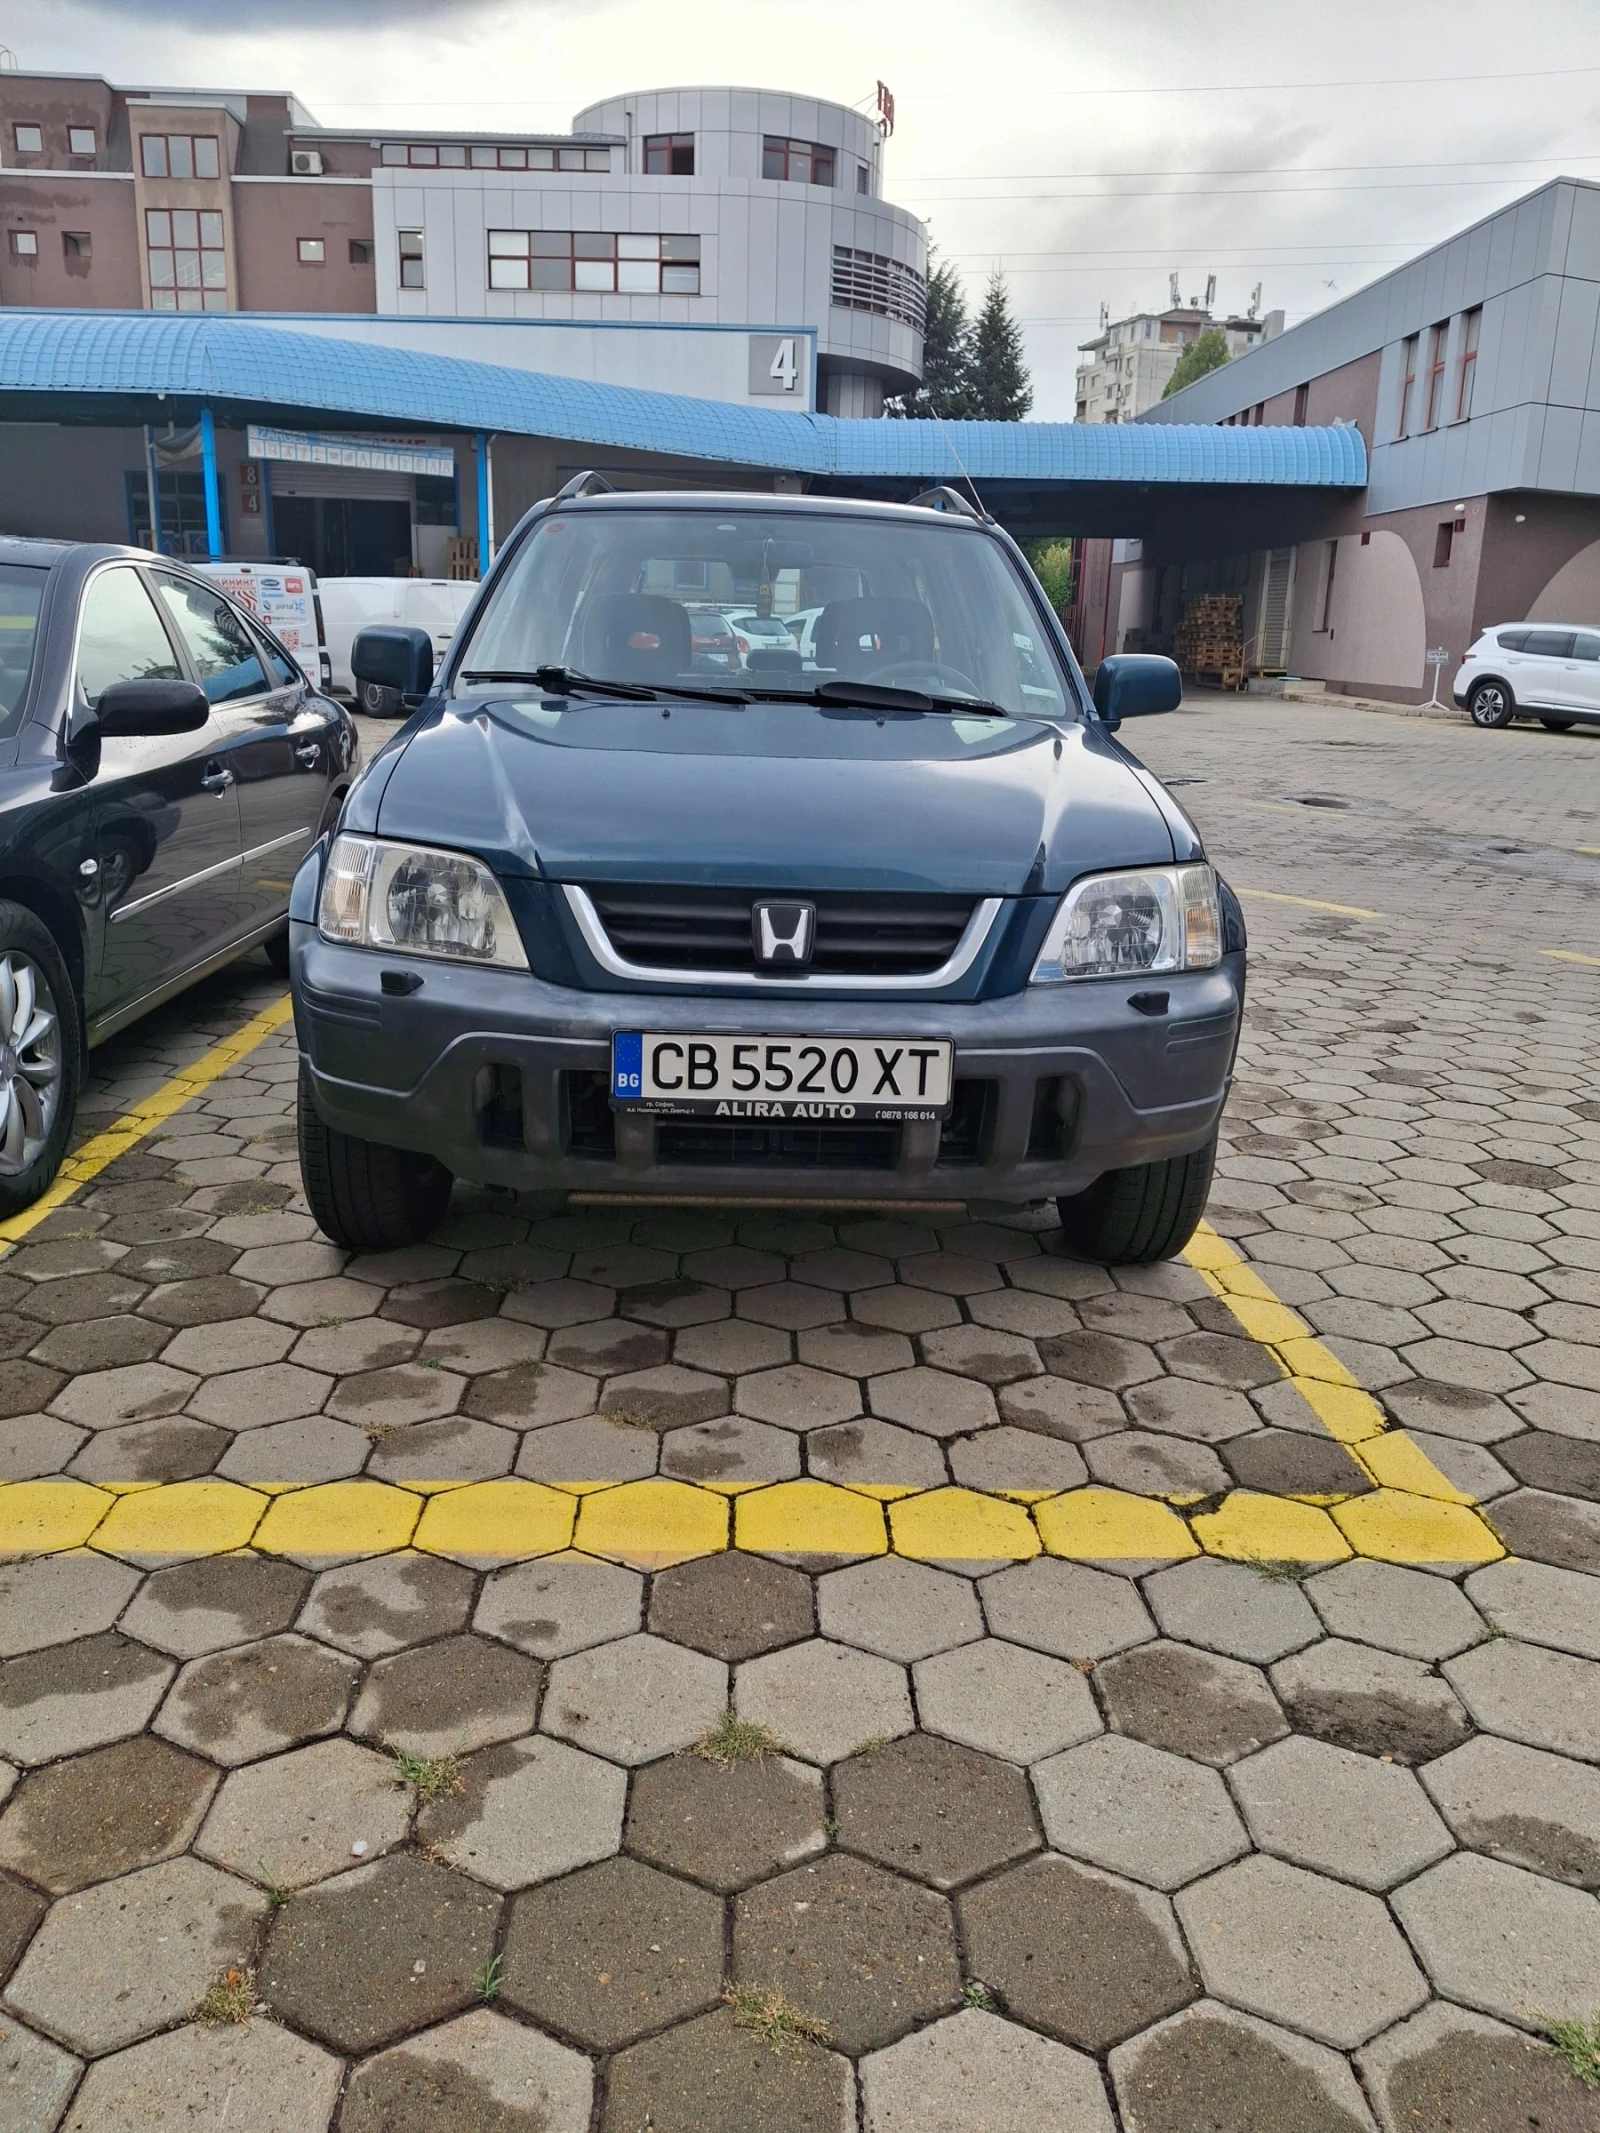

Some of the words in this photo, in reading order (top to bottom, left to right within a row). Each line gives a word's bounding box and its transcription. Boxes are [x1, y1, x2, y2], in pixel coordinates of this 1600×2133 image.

[770, 339, 798, 390] 4
[257, 427, 309, 444] ZARGES
[247, 466, 256, 484] 8
[248, 495, 258, 512] 4
[652, 1042, 719, 1090] CB
[732, 1045, 859, 1094] 5520
[872, 1048, 940, 1096] XT
[617, 1073, 640, 1088] BG
[715, 1101, 786, 1117] ALIRA
[791, 1103, 856, 1119] AUTO
[881, 1110, 902, 1119] 0878
[903, 1111, 919, 1120] 166
[920, 1111, 936, 1120] 614
